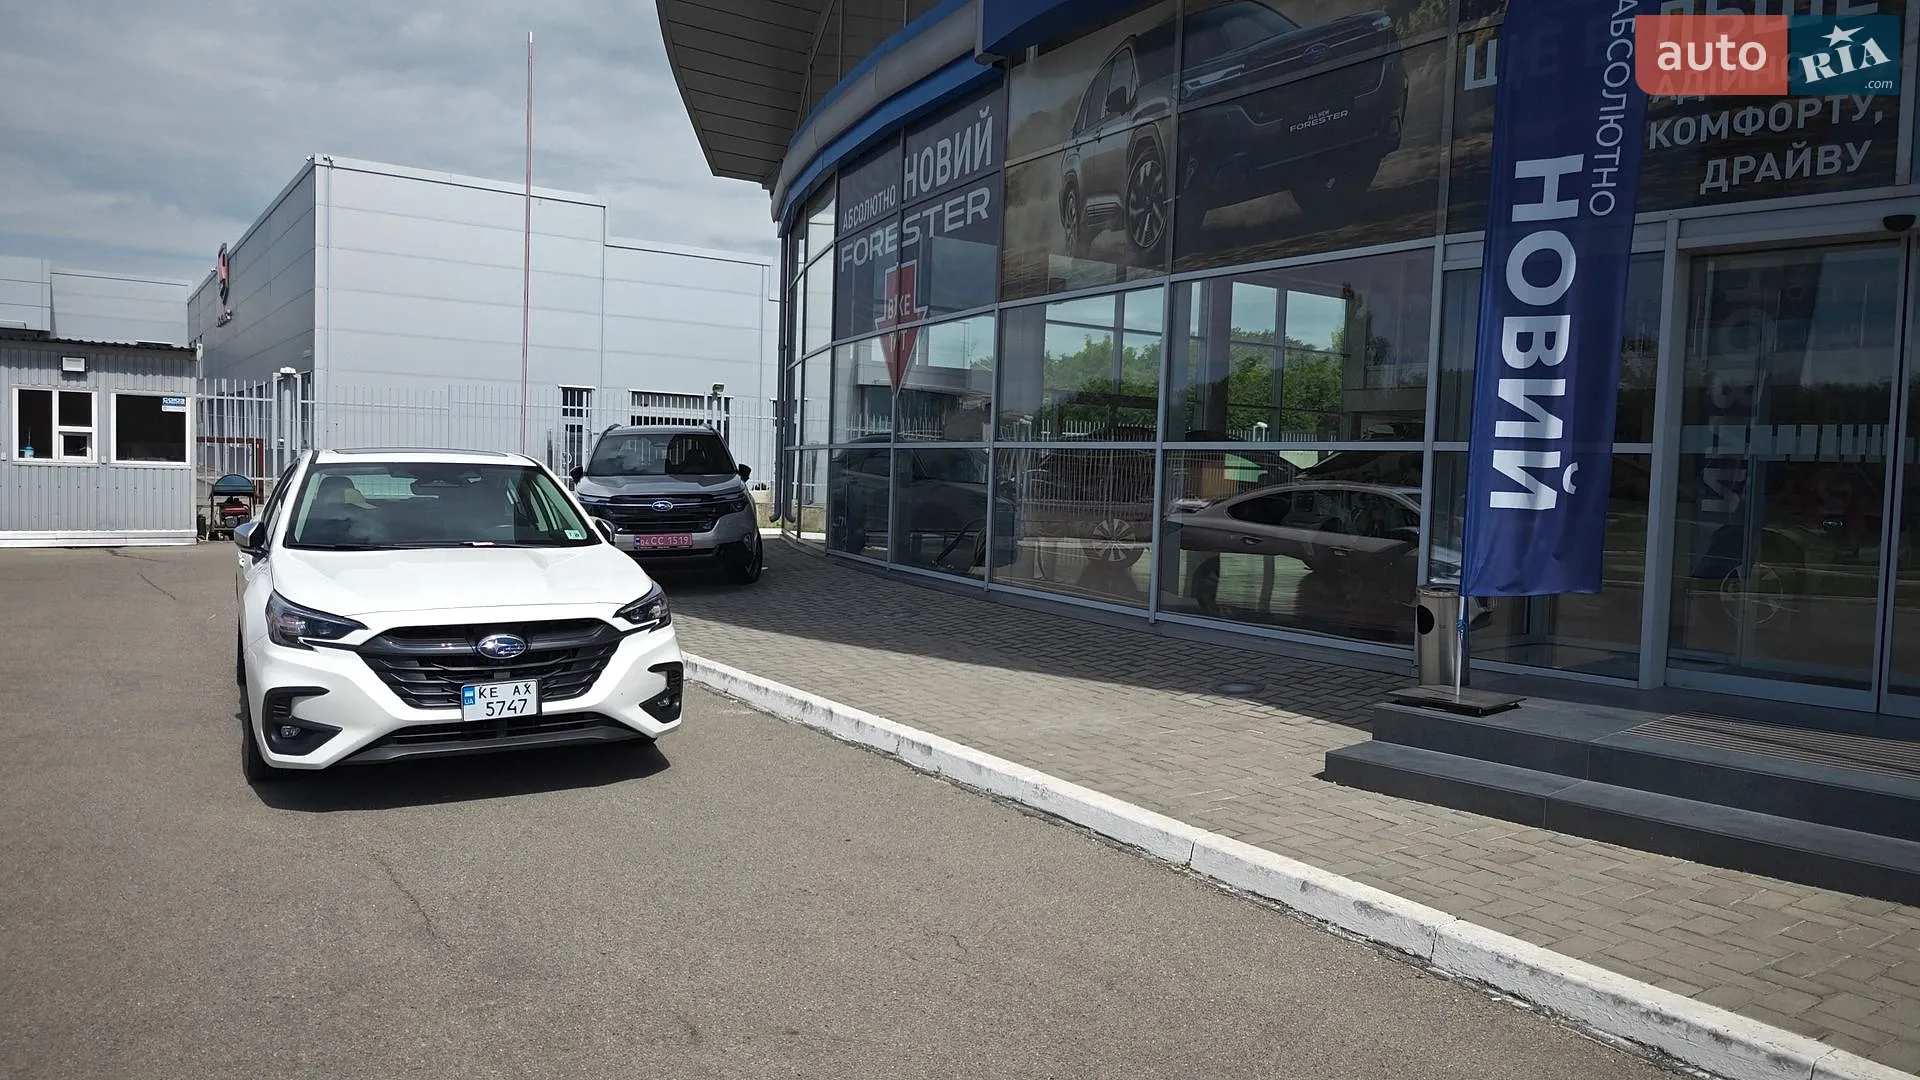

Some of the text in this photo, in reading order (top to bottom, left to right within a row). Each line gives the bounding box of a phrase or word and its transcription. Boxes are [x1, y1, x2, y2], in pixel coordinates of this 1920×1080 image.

[1289, 109, 1349, 133] FORESTER
[1589, 0, 1638, 217] АБСОЛЮТНО
[1648, 94, 1883, 150] КОМФОРТУ,
[904, 105, 993, 198] НОВИЙ
[1700, 139, 1873, 195] ДРАЙВУ
[840, 186, 991, 272] FORESTER
[842, 184, 896, 233] АБСОЛЮТНО
[1489, 153, 1585, 511] НОВИЙ
[667, 535, 689, 545] 1519
[464, 697, 474, 705] UA
[478, 683, 532, 699] KE AX
[485, 698, 528, 717] 5747
